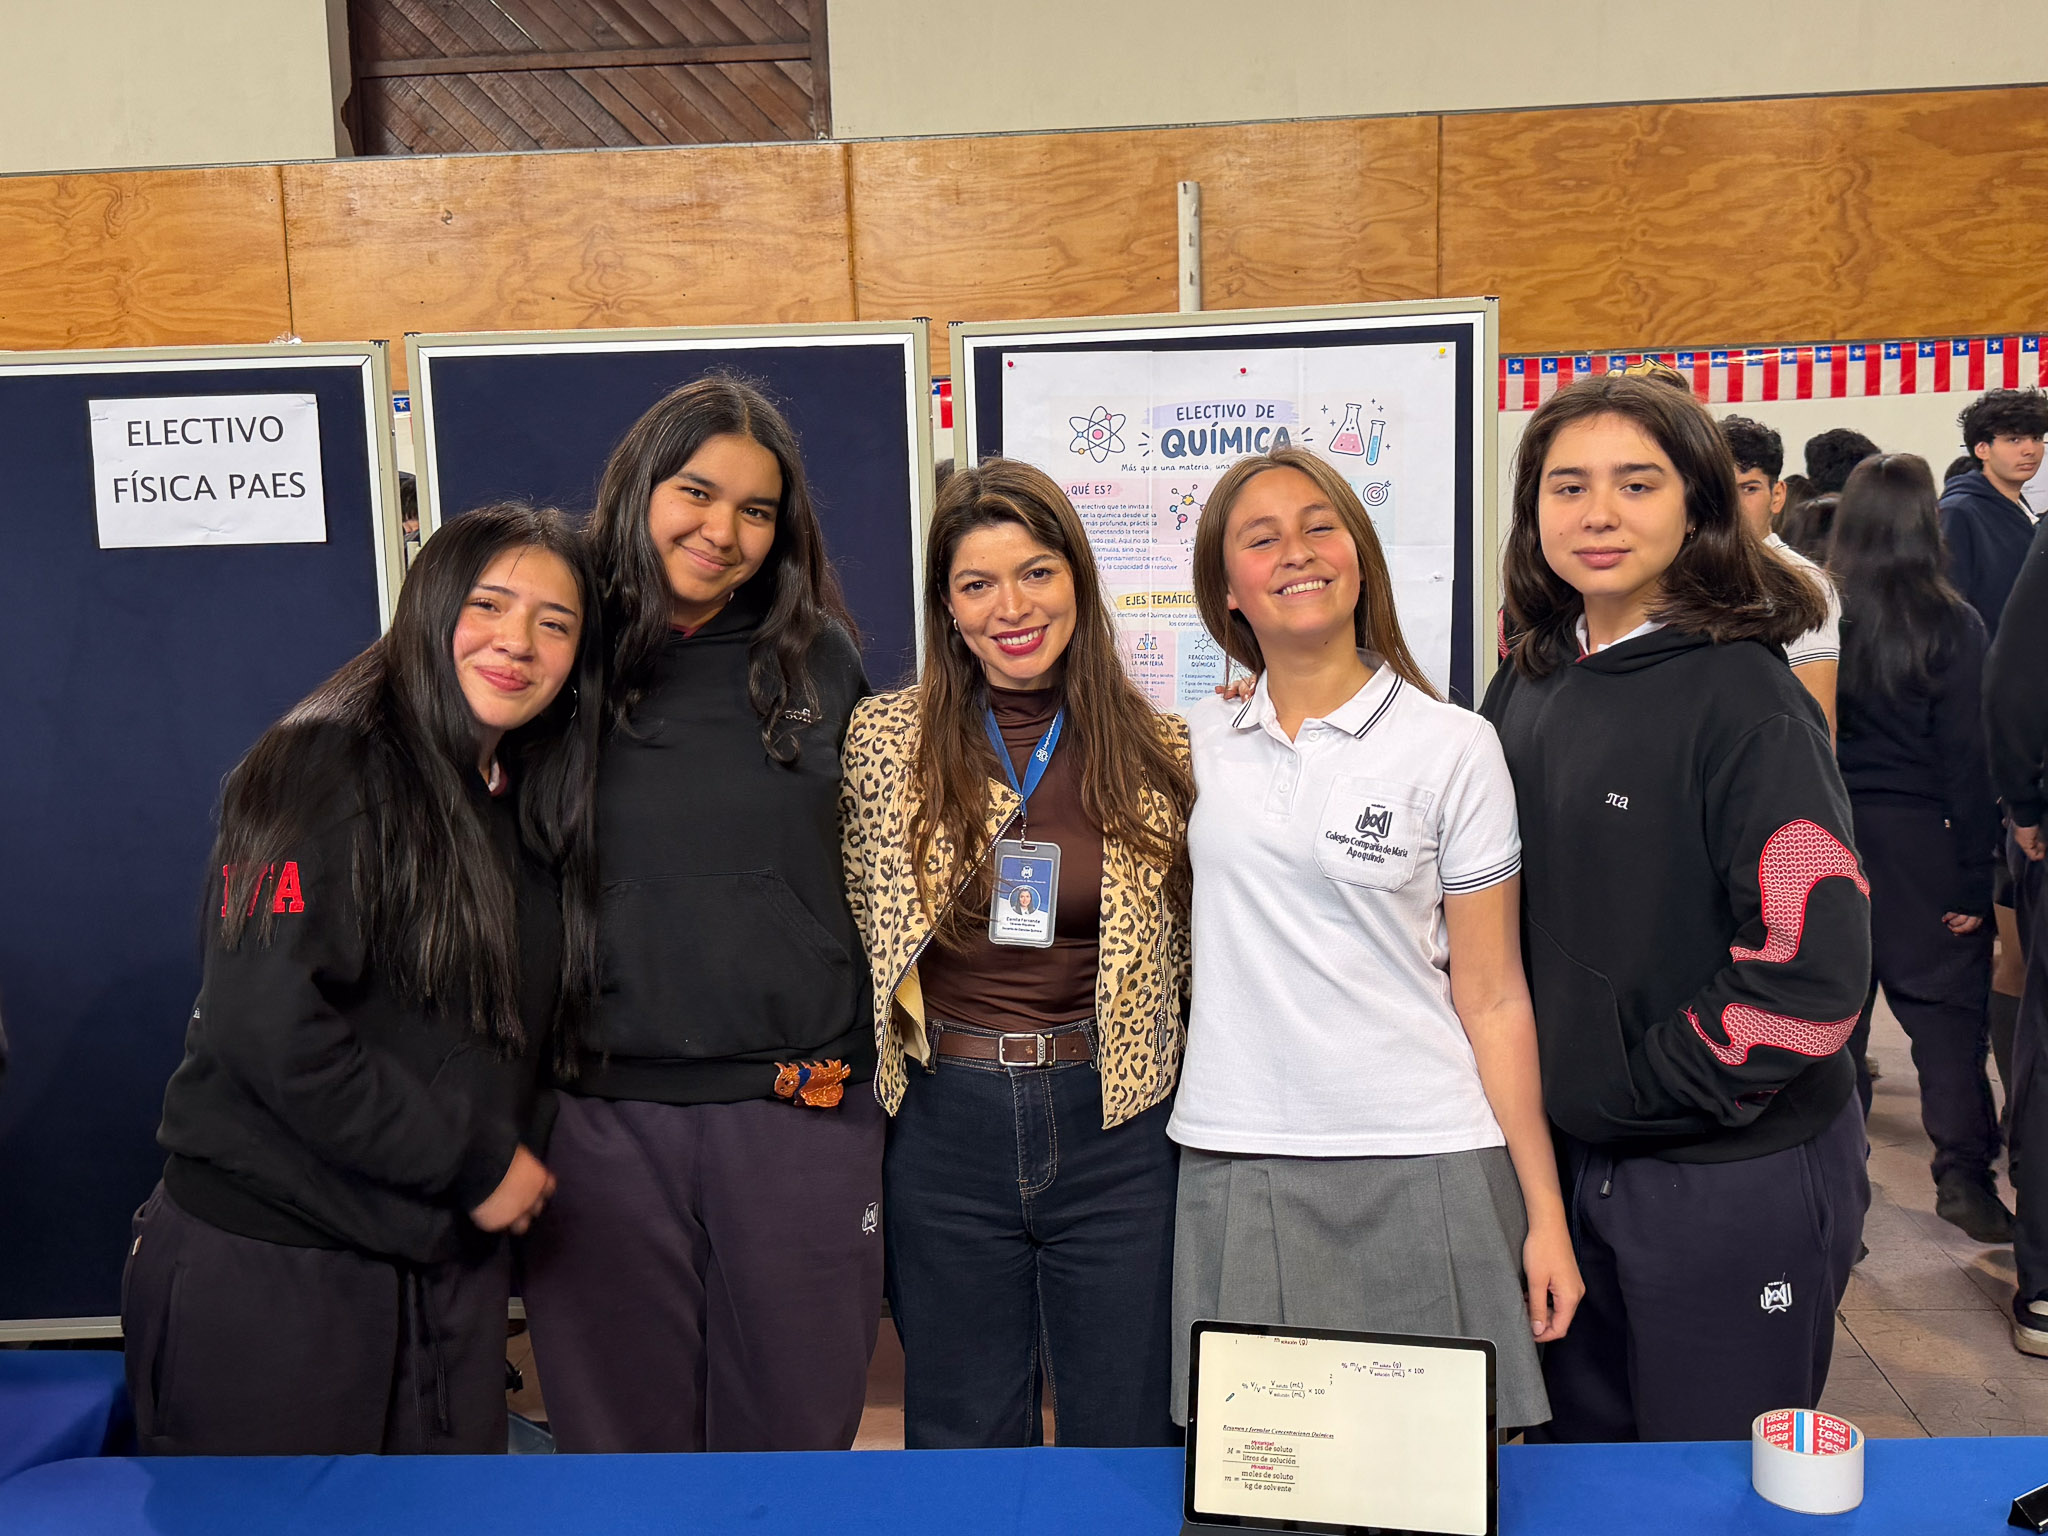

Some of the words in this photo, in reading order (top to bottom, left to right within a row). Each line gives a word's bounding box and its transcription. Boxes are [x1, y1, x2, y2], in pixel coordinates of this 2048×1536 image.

[1176, 404, 1246, 421] ELECTIVO
[1256, 404, 1275, 419] DE
[127, 415, 284, 446] ELECTIVO
[1161, 421, 1292, 459] QUÍMICA
[1121, 464, 1137, 472] Más
[1179, 464, 1212, 472] materia,
[113, 470, 217, 503] FÍSICA
[229, 472, 306, 499] PAES
[1066, 483, 1090, 497] ¿QUÉ
[1094, 485, 1112, 495] ES?
[1113, 563, 1144, 571] capacidad
[1125, 595, 1147, 606] EJES
[1325, 831, 1350, 844] Colegio
[1383, 845, 1392, 855] de
[1346, 846, 1385, 864] Apoquindo
[1766, 1422, 1789, 1434] tesa
[1817, 1416, 1846, 1433] tesa
[1817, 1427, 1846, 1445] tesa
[1264, 1444, 1272, 1452] de
[1273, 1445, 1293, 1454] soluto
[1242, 1454, 1259, 1462] litros
[1269, 1456, 1296, 1465] solución
[1241, 1470, 1262, 1478] moles
[1263, 1471, 1271, 1479] de
[1272, 1472, 1294, 1481] soluto
[1244, 1482, 1253, 1491] kg
[1263, 1484, 1292, 1493] solvente
